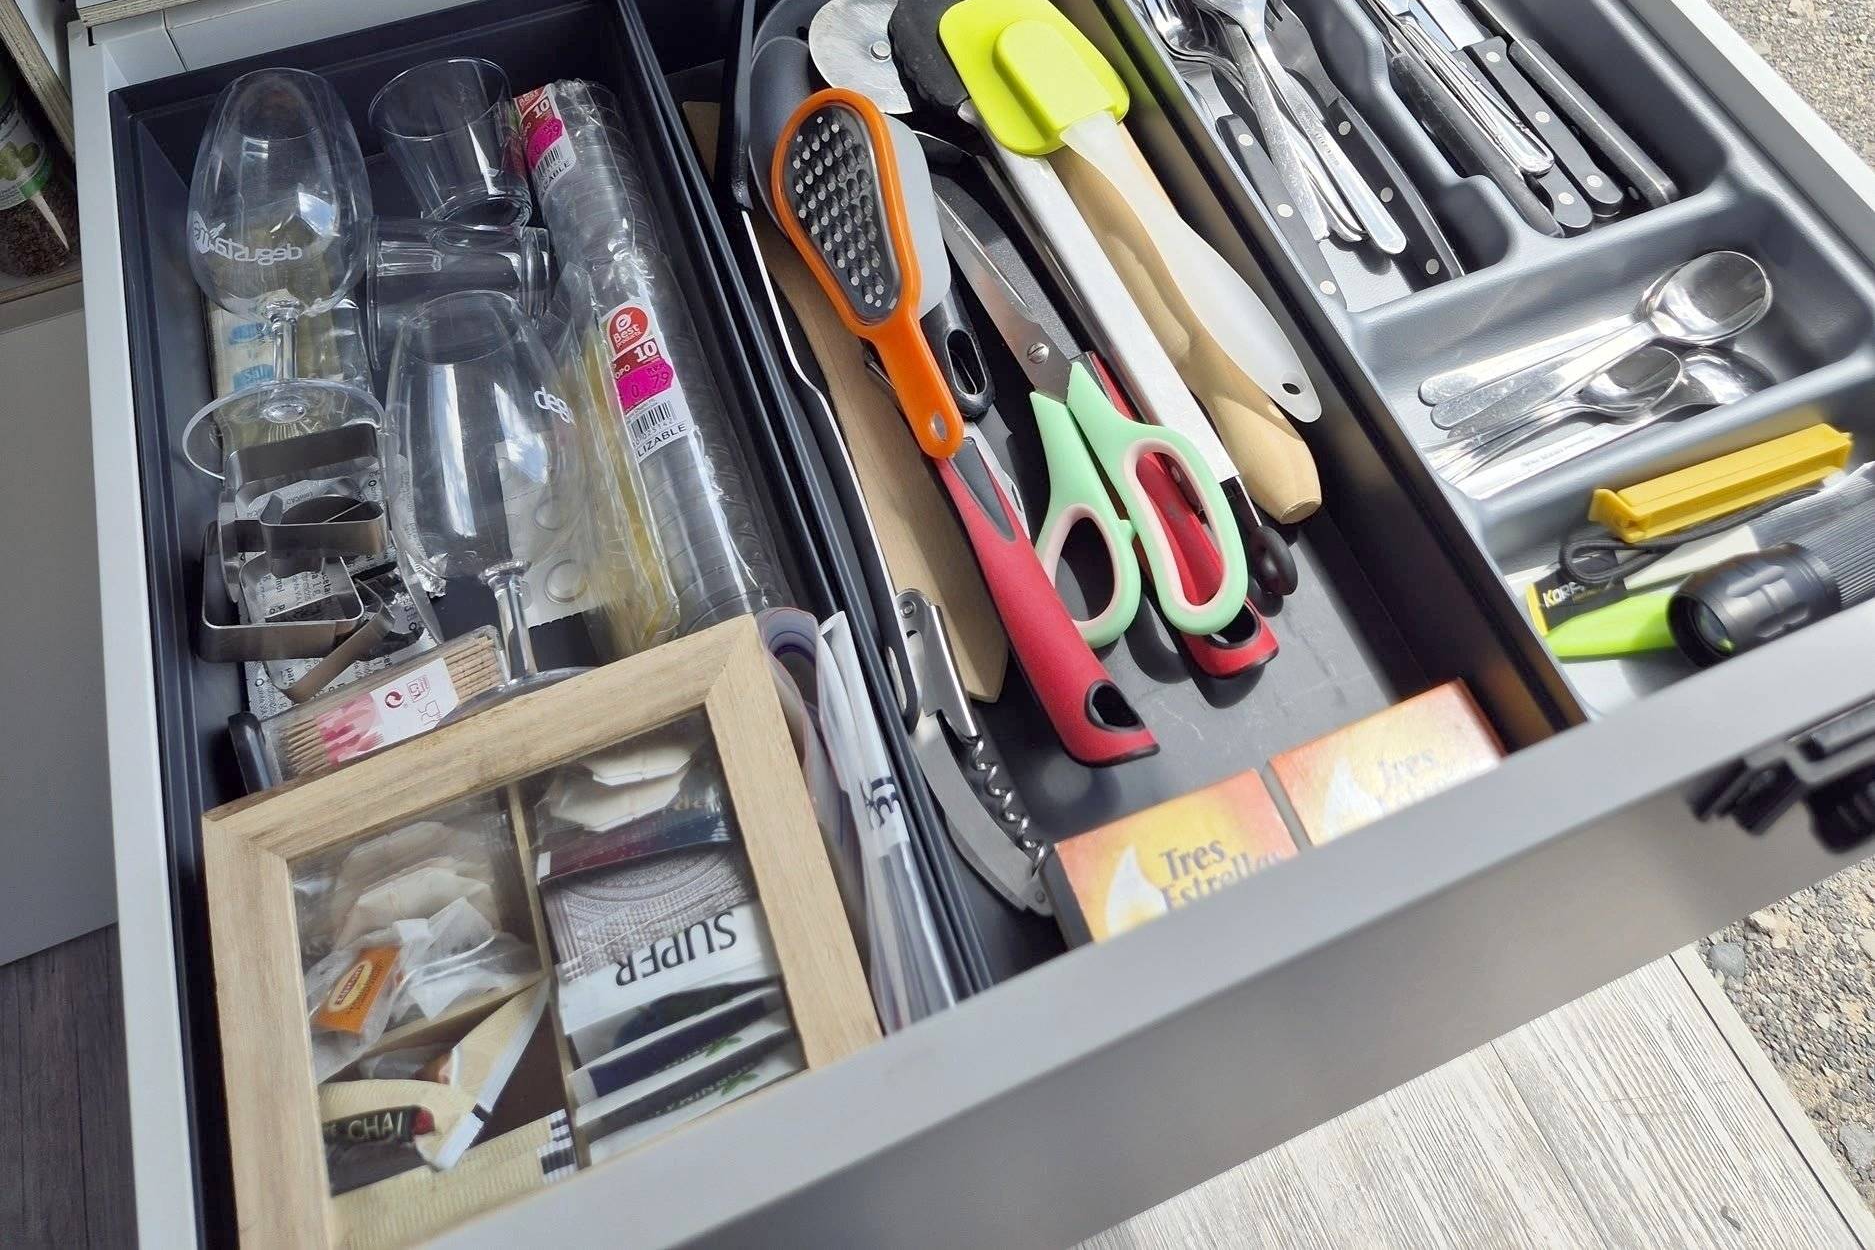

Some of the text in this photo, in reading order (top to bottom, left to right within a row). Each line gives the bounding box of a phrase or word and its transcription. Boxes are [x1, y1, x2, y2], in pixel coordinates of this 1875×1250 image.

[533, 98, 551, 119] 10
[612, 321, 641, 346] Best
[636, 341, 658, 363] 10
[637, 423, 688, 459] LIZABLE
[1160, 839, 1226, 881] Tres
